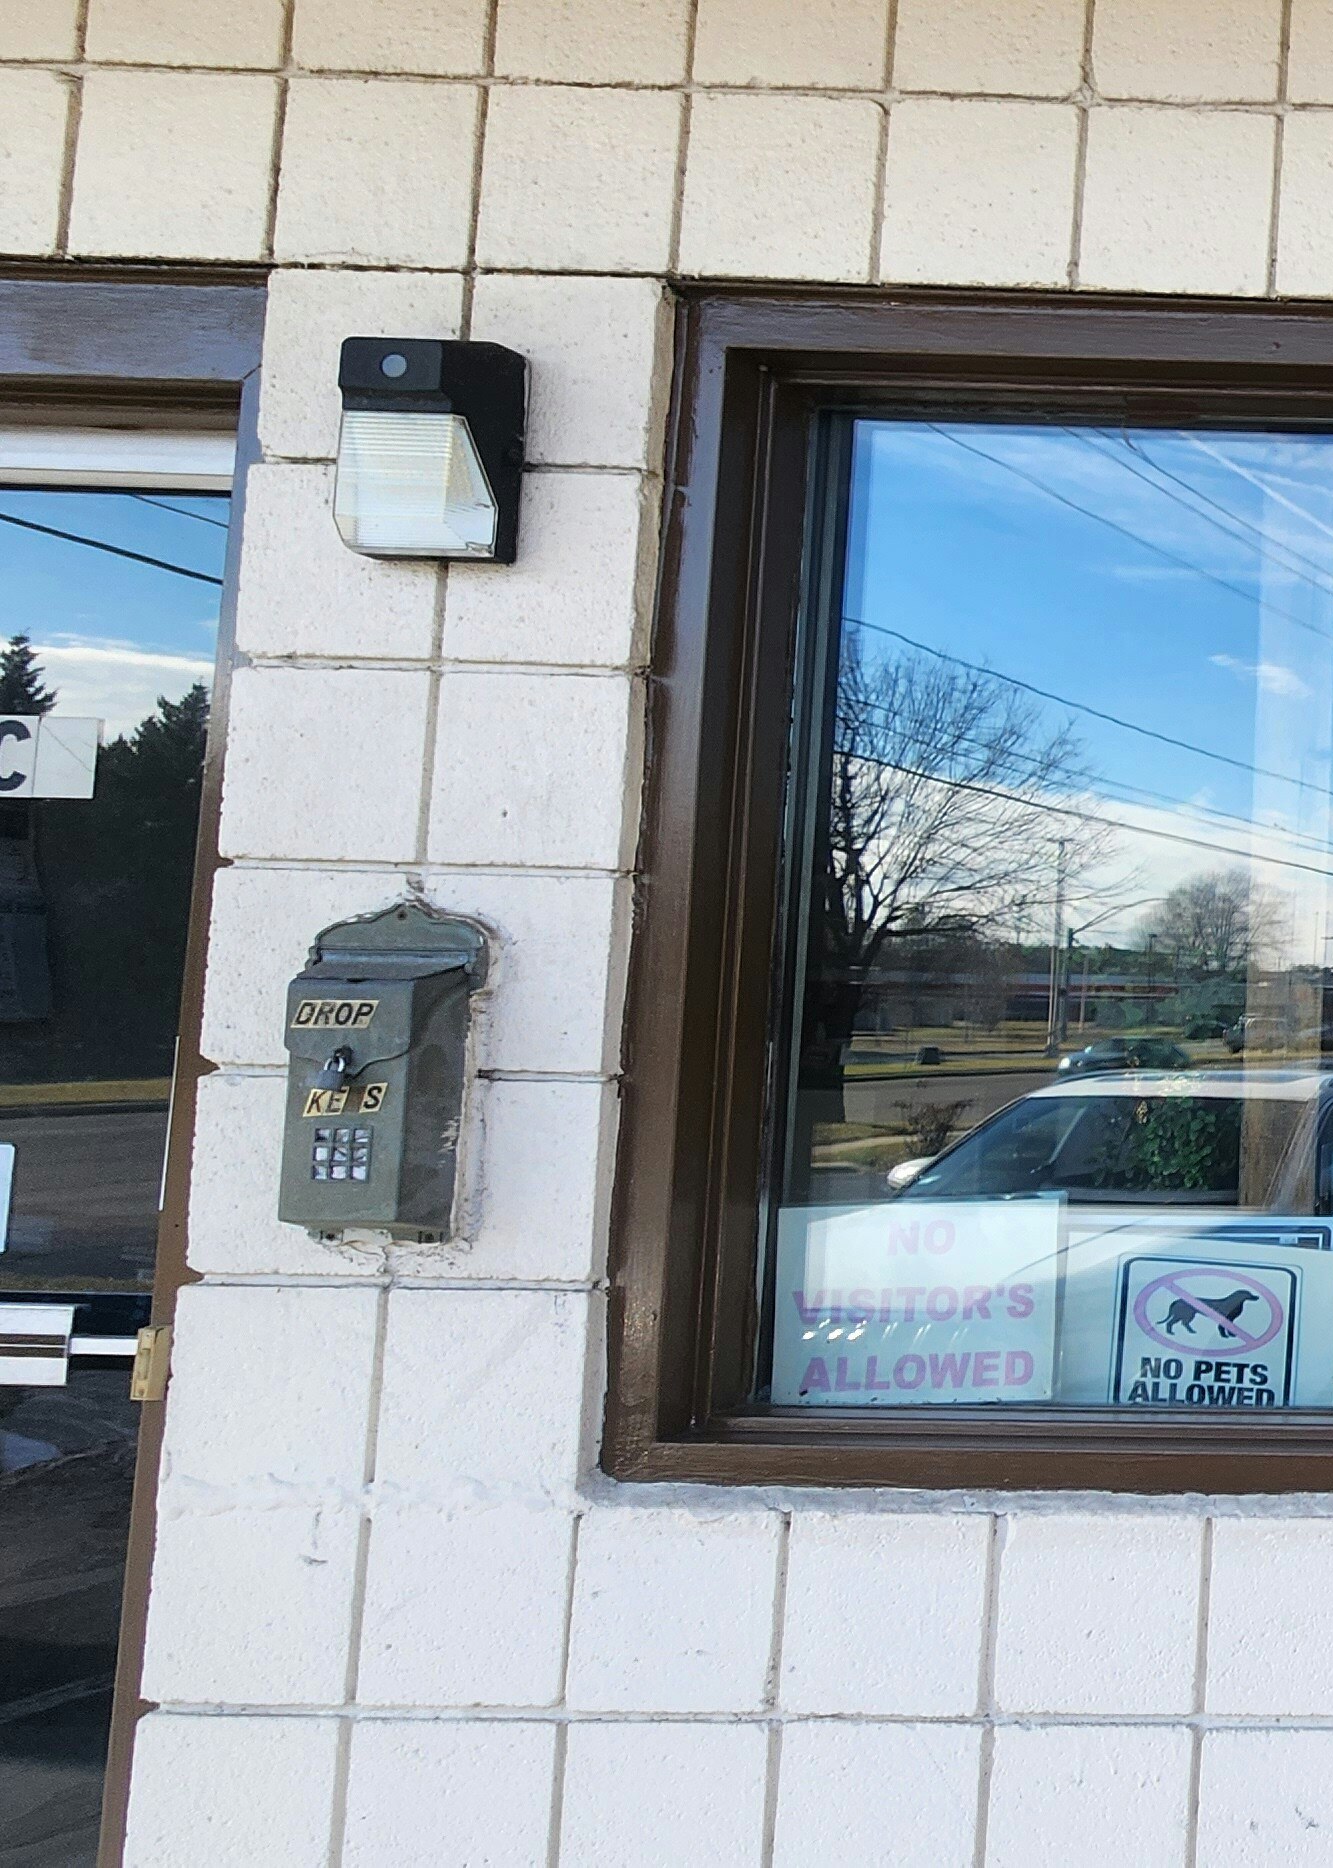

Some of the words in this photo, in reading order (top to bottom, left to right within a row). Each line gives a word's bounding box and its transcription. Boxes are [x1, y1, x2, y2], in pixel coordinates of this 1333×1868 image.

[294, 1002, 374, 1026] DROP
[887, 1219, 956, 1256] NO
[792, 1282, 1035, 1325] VISITOR'S
[799, 1350, 1035, 1393] ALLOWED
[1140, 1357, 1184, 1380] NO
[1193, 1360, 1269, 1386] PETS
[1128, 1381, 1275, 1407] ALLOWED
